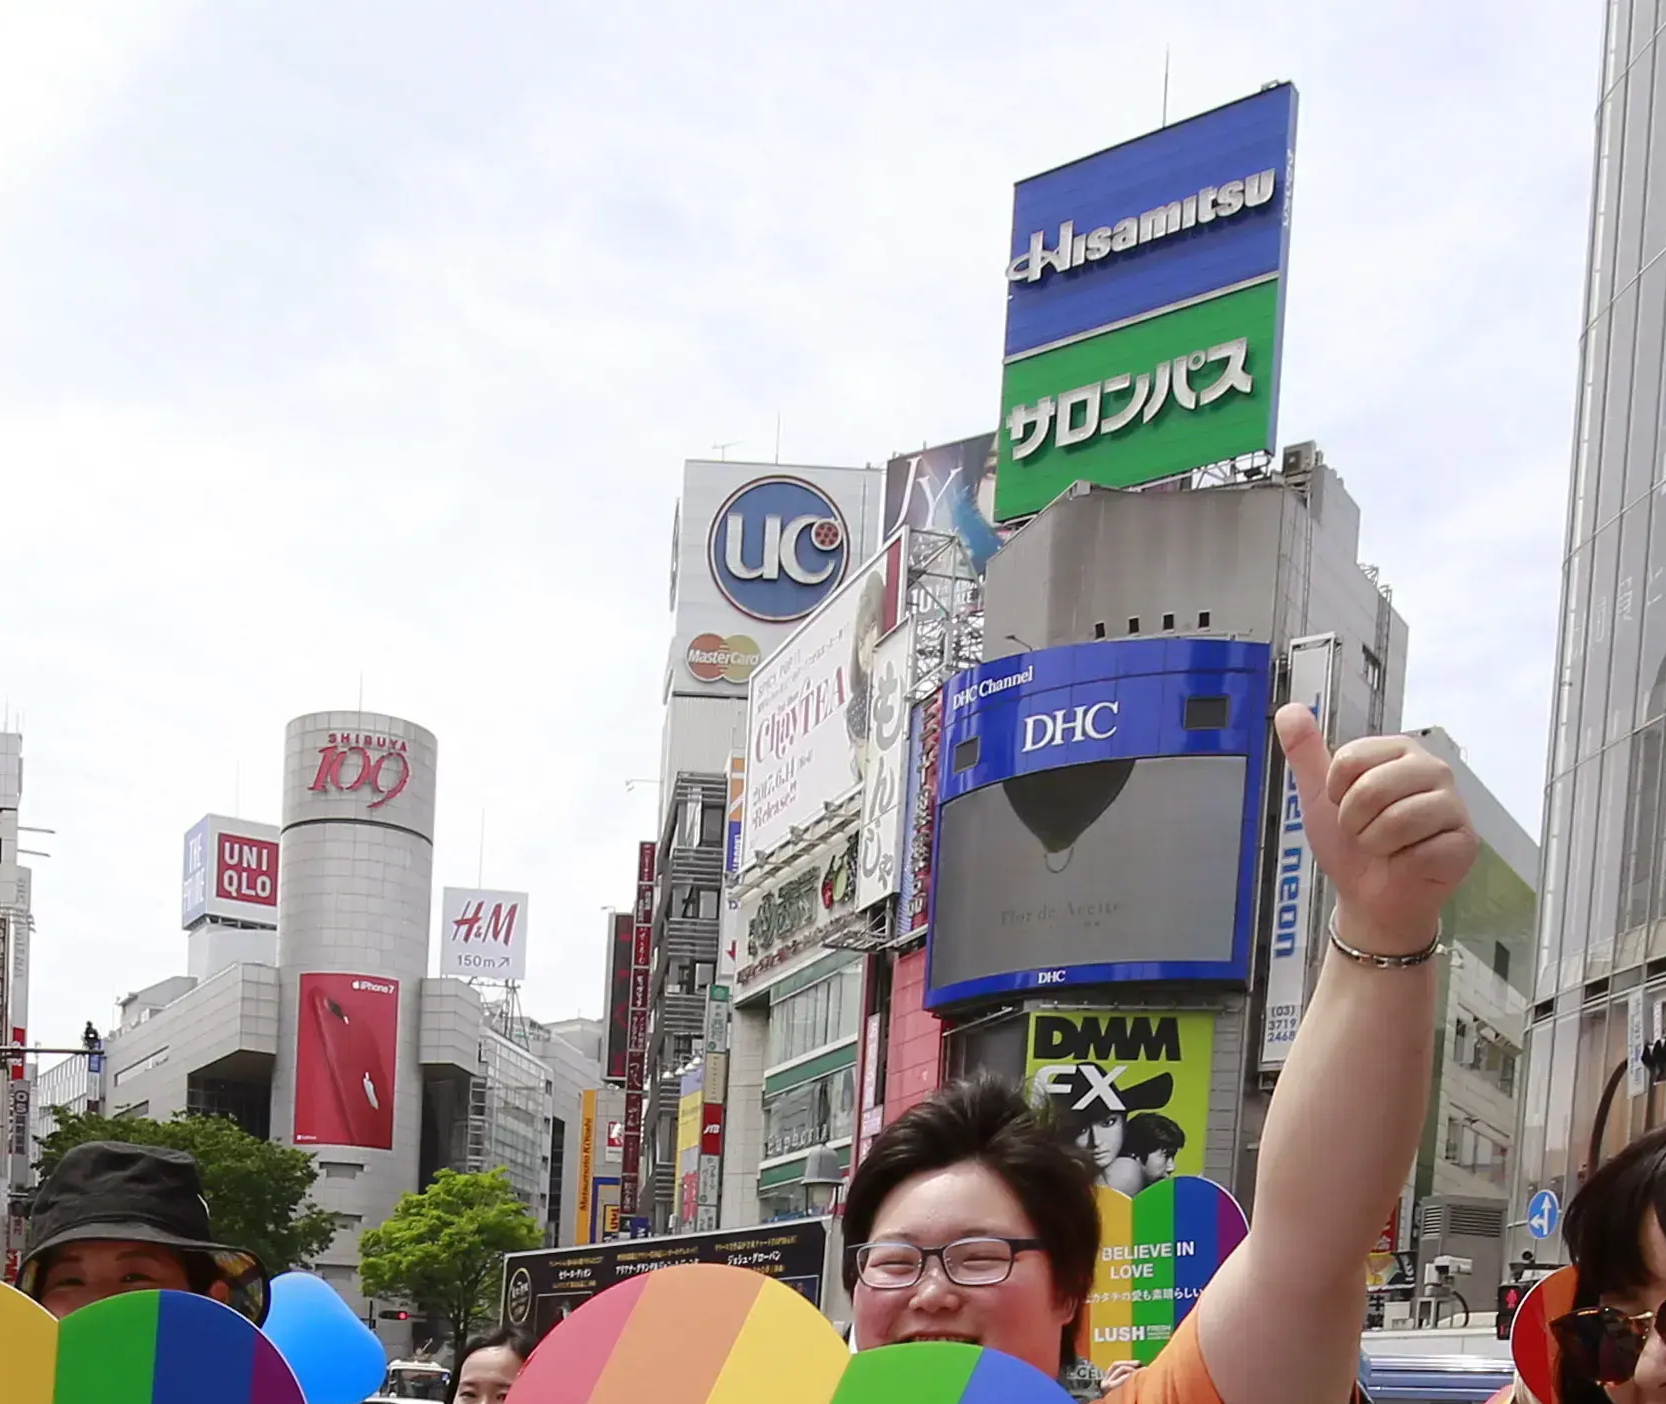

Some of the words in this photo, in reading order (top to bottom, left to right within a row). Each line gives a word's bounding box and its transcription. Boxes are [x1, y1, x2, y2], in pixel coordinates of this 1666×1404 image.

[1005, 168, 1277, 282] Hisamitsu
[1005, 336, 1254, 462] サロンパス
[688, 648, 761, 667] MasterCard
[952, 682, 977, 709] DHC
[979, 666, 1034, 699] Channel
[1020, 701, 1120, 754] DHC
[328, 733, 409, 752] SHIBUYA
[308, 745, 411, 809] 109
[223, 841, 270, 871] UNI
[223, 869, 272, 899] QLO
[450, 899, 519, 946] H&M
[456, 954, 497, 969] 150m
[1038, 969, 1066, 985] DHC
[1271, 1005, 1295, 1018] (03)
[1267, 1018, 1297, 1031] 3719
[1032, 1015, 1182, 1062] DMM
[1101, 1243, 1173, 1262] BELIEVE
[1176, 1241, 1195, 1257] IN
[1109, 1263, 1155, 1280] LOVE
[1084, 1286, 1203, 1305] カタチの愛も素晴らしい
[1094, 1325, 1146, 1343] LUSH
